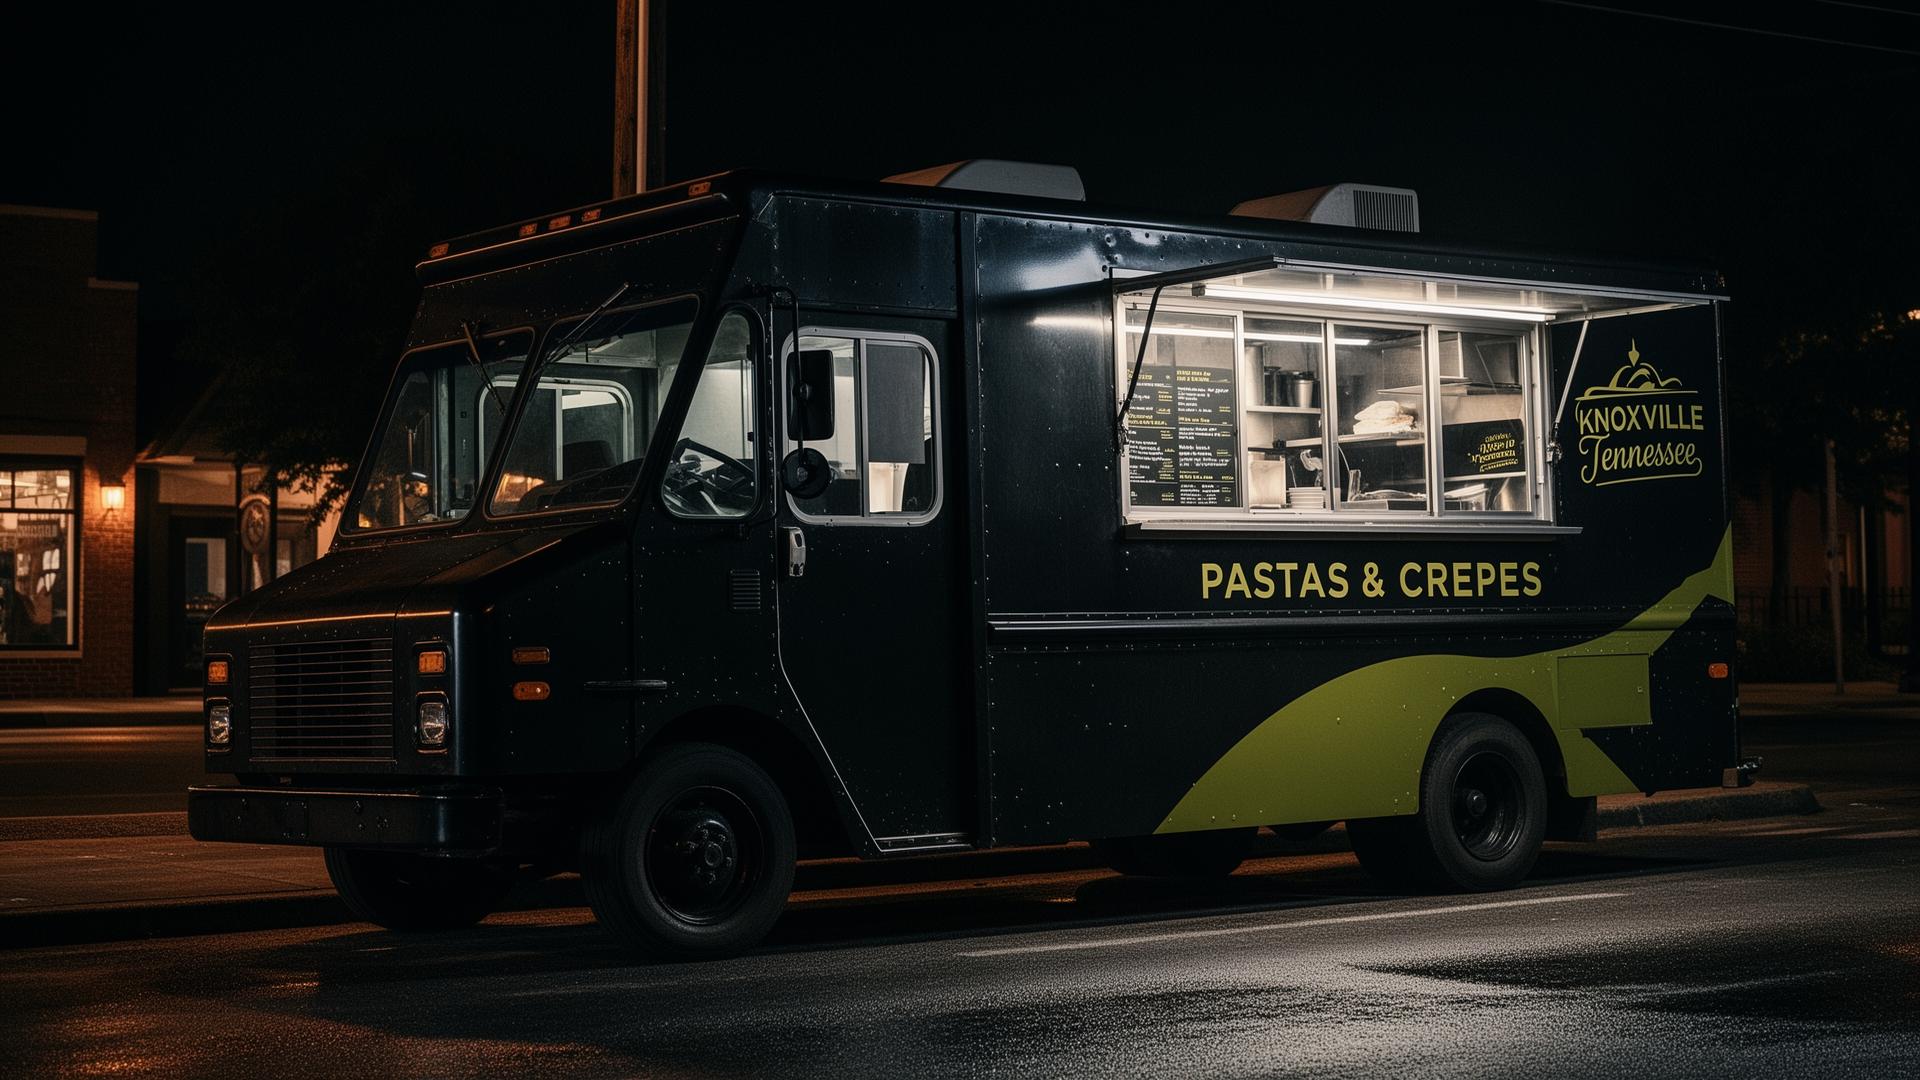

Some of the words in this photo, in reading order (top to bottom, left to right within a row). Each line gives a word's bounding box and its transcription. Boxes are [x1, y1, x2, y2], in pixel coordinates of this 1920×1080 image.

[1580, 404, 1704, 435] KNOXVILLE
[1579, 433, 1702, 484] Tennessee
[1201, 562, 1349, 599] PASTAS
[1362, 562, 1385, 598] &
[1399, 562, 1542, 597] CREPES
